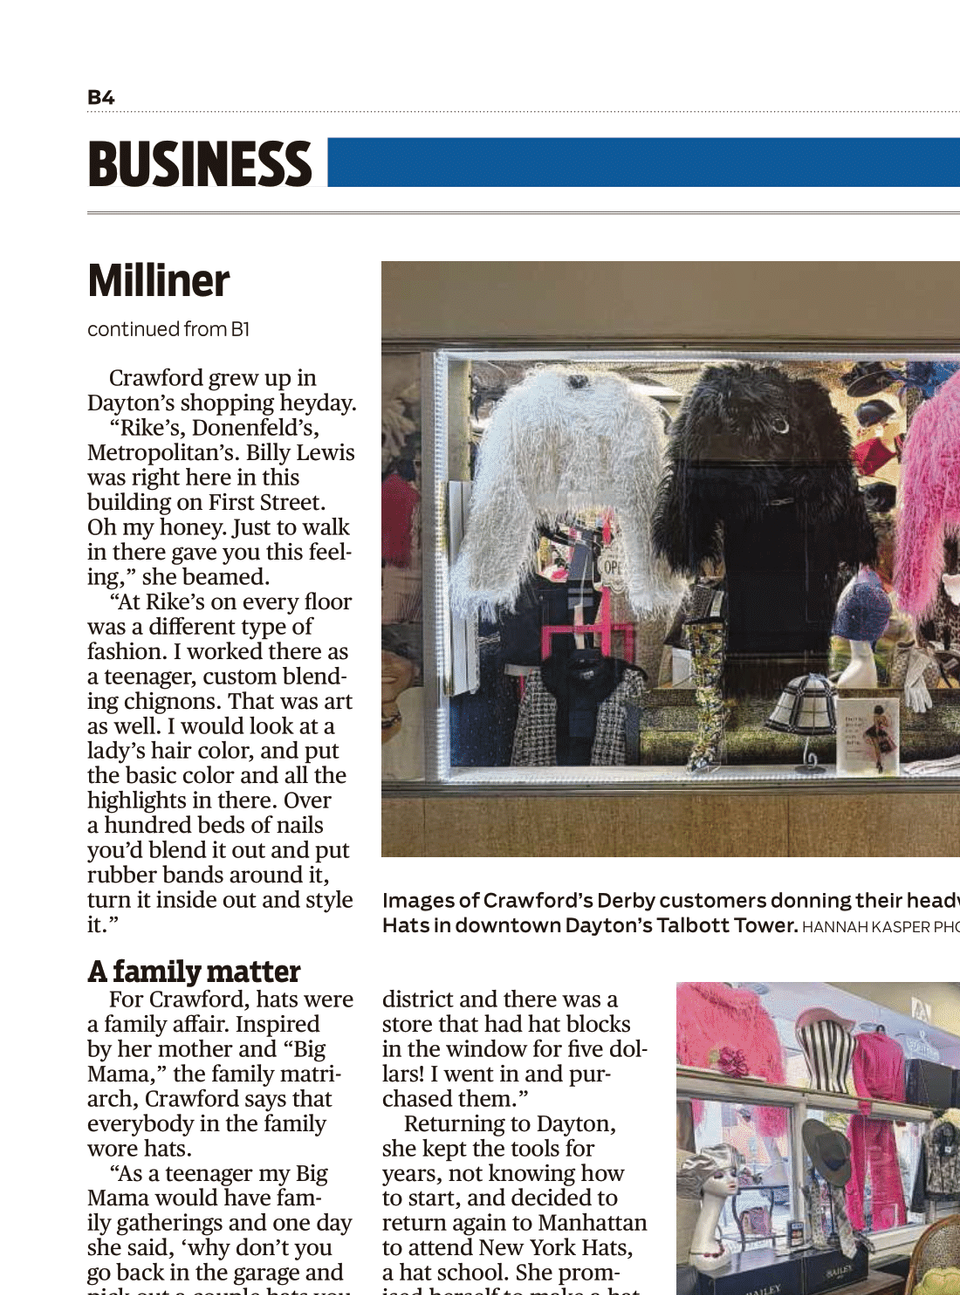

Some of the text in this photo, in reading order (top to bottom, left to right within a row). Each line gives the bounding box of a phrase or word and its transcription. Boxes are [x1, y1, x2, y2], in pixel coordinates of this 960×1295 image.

[88, 89, 115, 105] B4
[89, 140, 312, 187] BUSINESS
[90, 262, 230, 297] Milliner
[88, 320, 248, 336] continued from B1
[384, 893, 455, 911] Images
[460, 892, 480, 908] of
[484, 892, 593, 908] Crawford’s
[599, 892, 655, 911] Derby
[660, 893, 766, 908] customers
[771, 892, 852, 911] donning
[855, 892, 903, 908] their
[88, 915, 118, 933] it.”
[384, 918, 429, 933] Hats
[435, 918, 450, 932] in
[456, 917, 561, 933] downtown
[567, 918, 652, 936] Dayton’s
[657, 917, 729, 933] Talbott
[734, 918, 798, 933] Tower.
[803, 921, 868, 932] HANNAH
[873, 921, 930, 933] KASPER
[88, 959, 301, 987] A family matter
[825, 1264, 853, 1279] BAILEY
